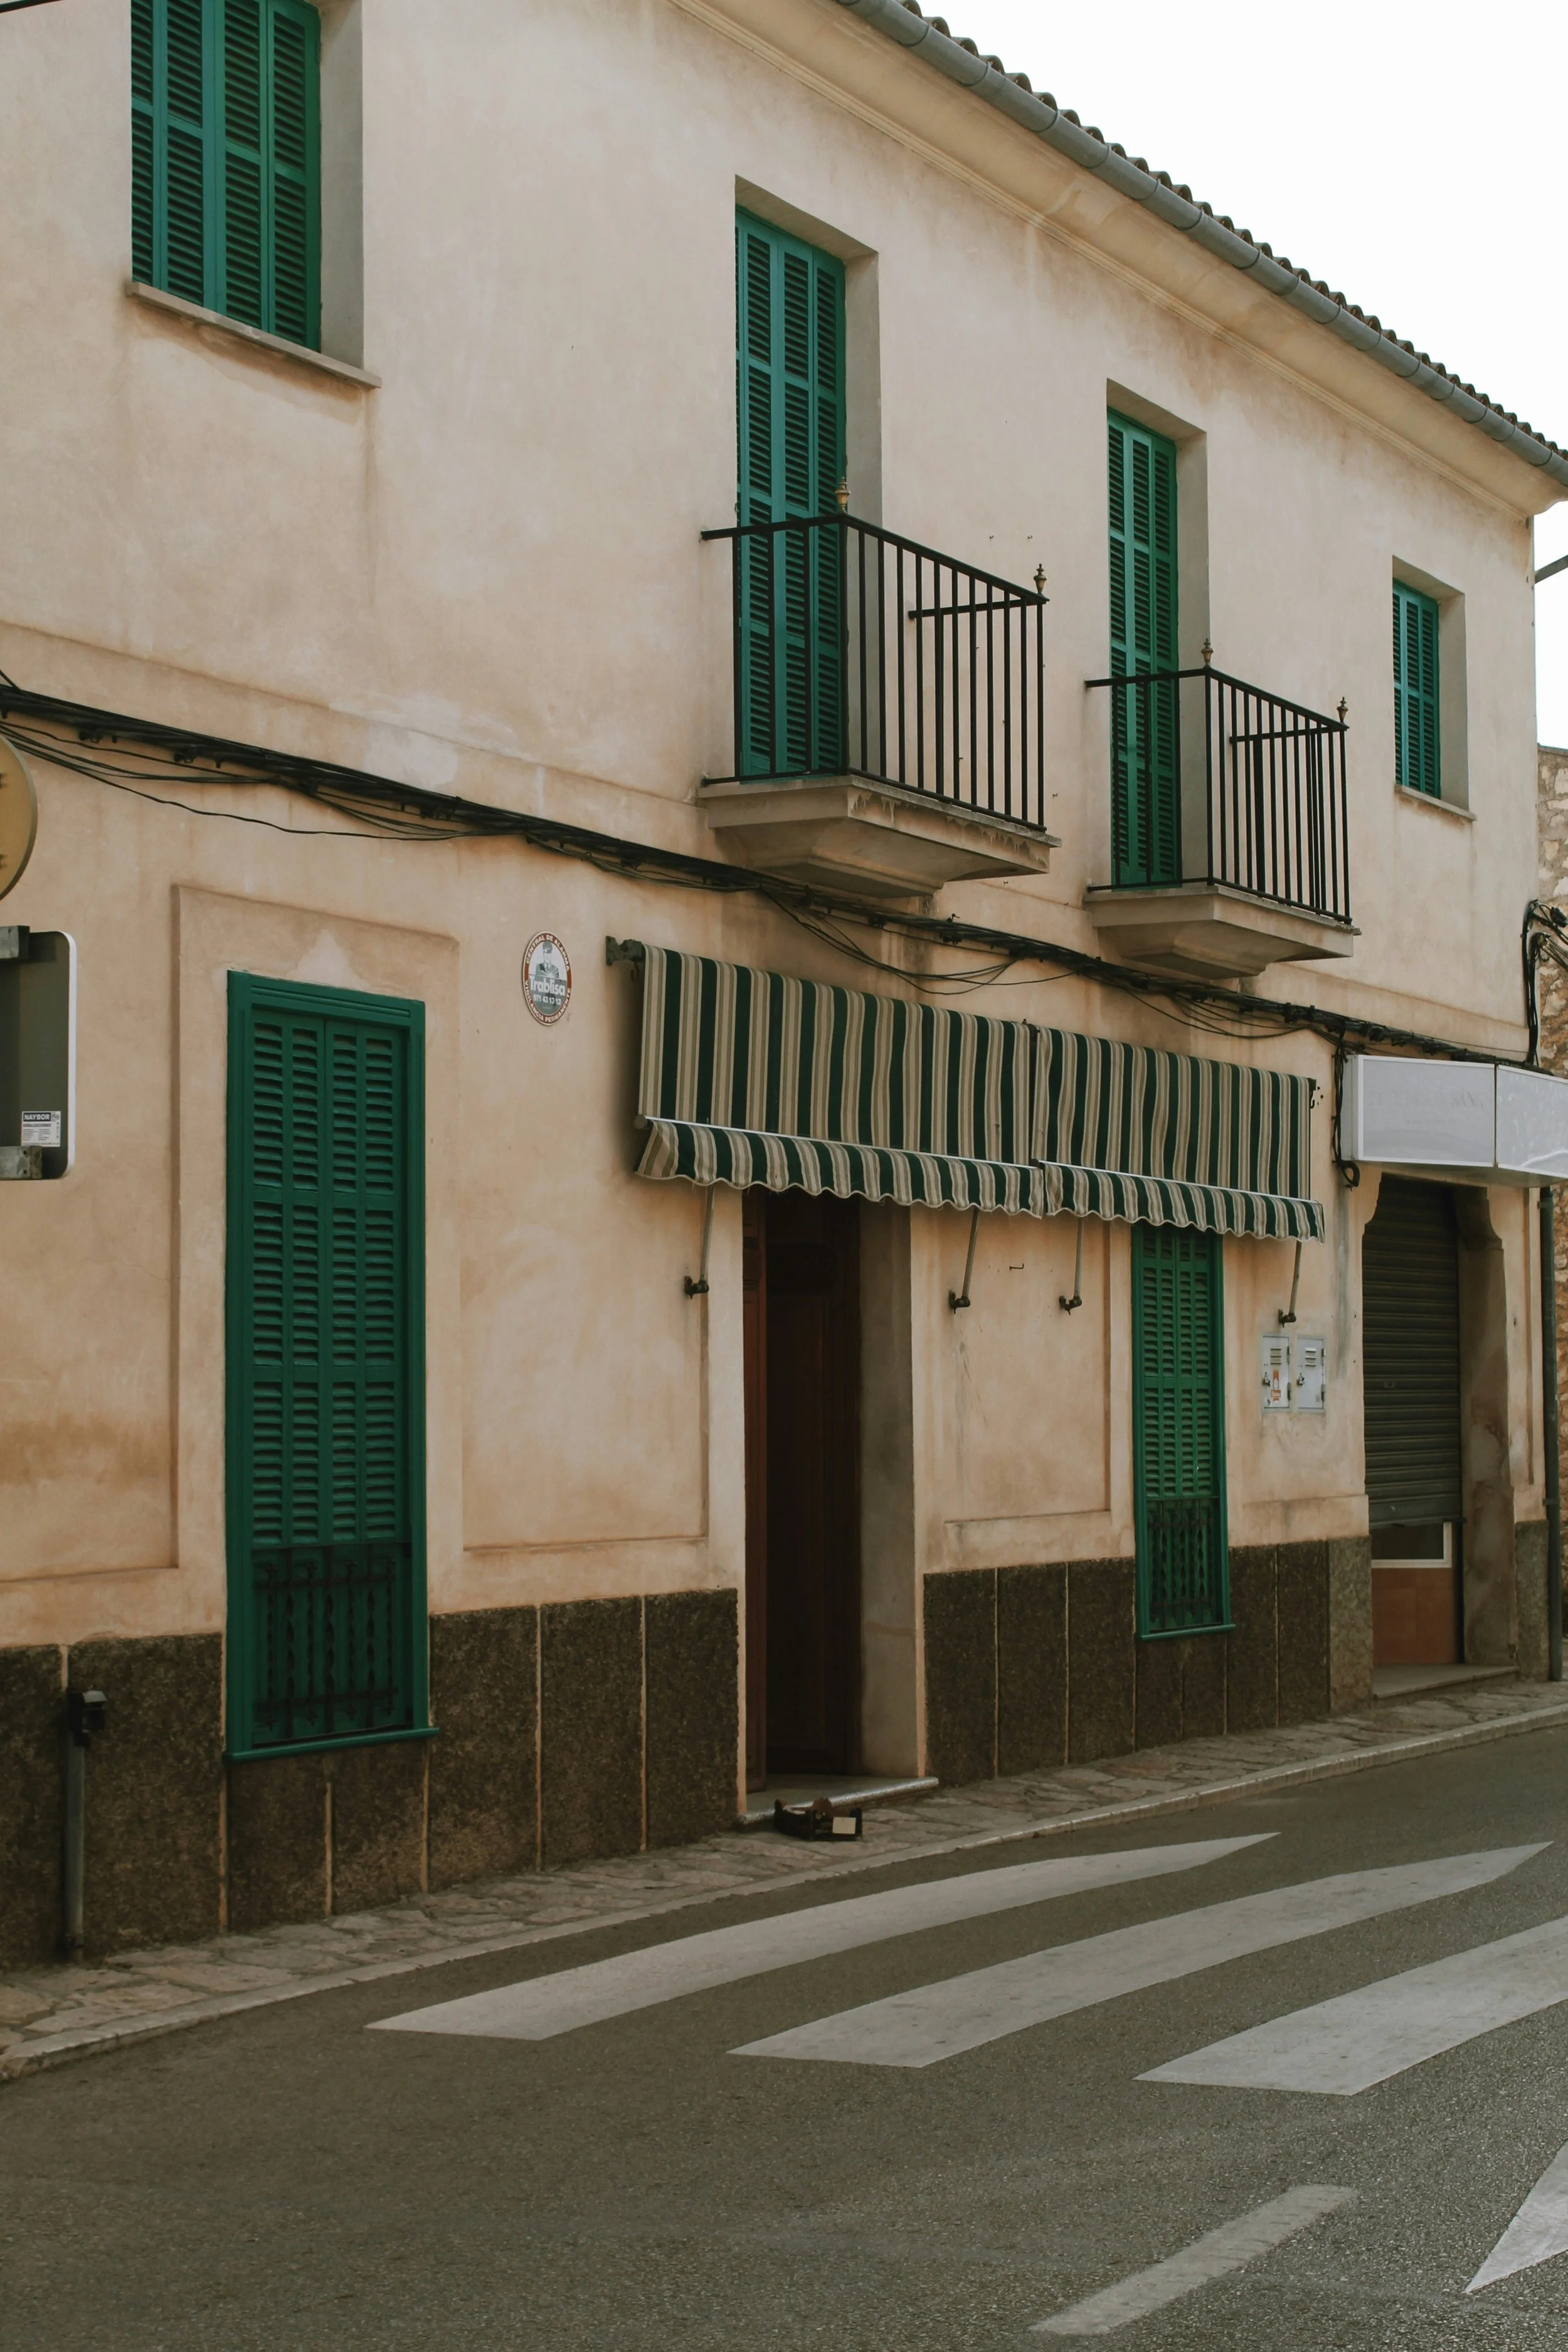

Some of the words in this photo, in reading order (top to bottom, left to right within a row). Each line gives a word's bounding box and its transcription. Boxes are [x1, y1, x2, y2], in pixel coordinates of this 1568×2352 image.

[526, 935, 545, 963] CENTRAL
[554, 940, 569, 971] ALARMA
[530, 977, 565, 996] Trablisa
[542, 995, 548, 1004] 43
[525, 980, 544, 1021] VIGILANCIA
[545, 988, 570, 1022] PERMANENTE
